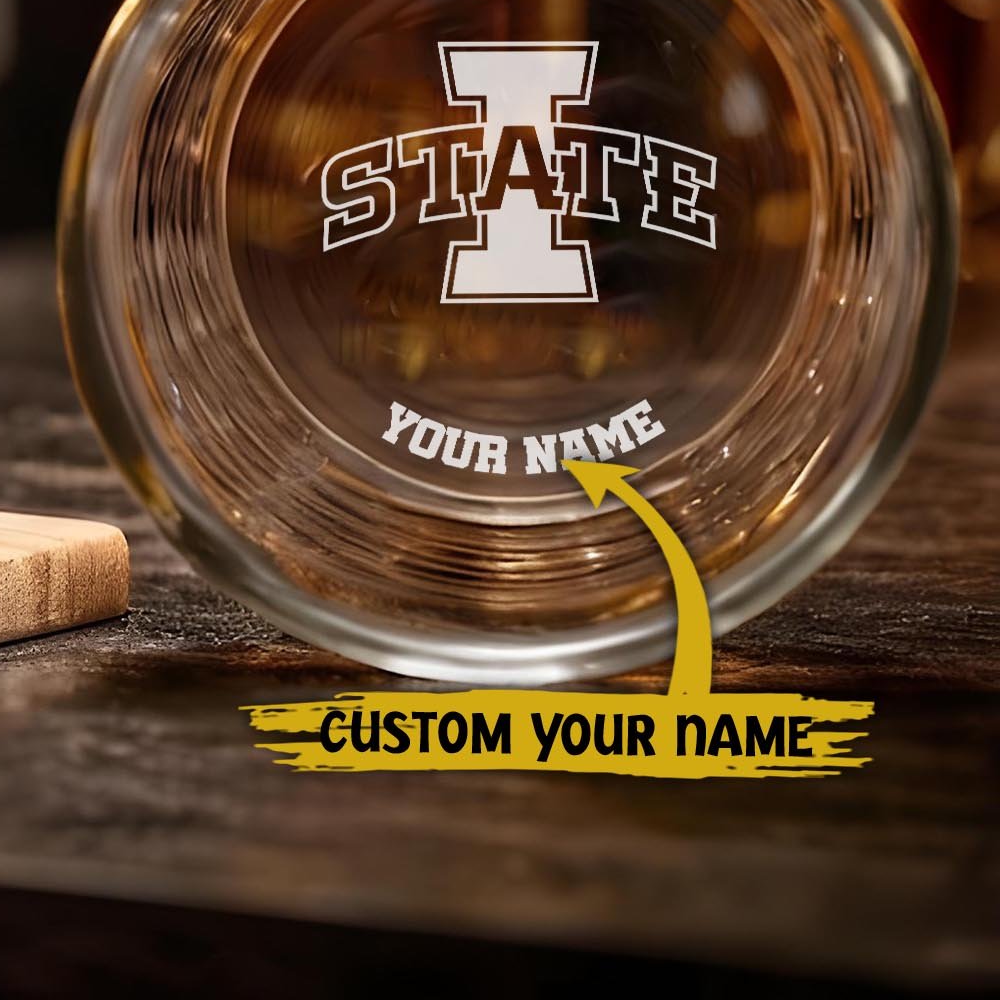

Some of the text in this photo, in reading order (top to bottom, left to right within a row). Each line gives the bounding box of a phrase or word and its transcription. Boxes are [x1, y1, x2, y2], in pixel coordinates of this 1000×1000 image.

[321, 122, 717, 252] STATE
[381, 399, 666, 475] YOUR NAME
